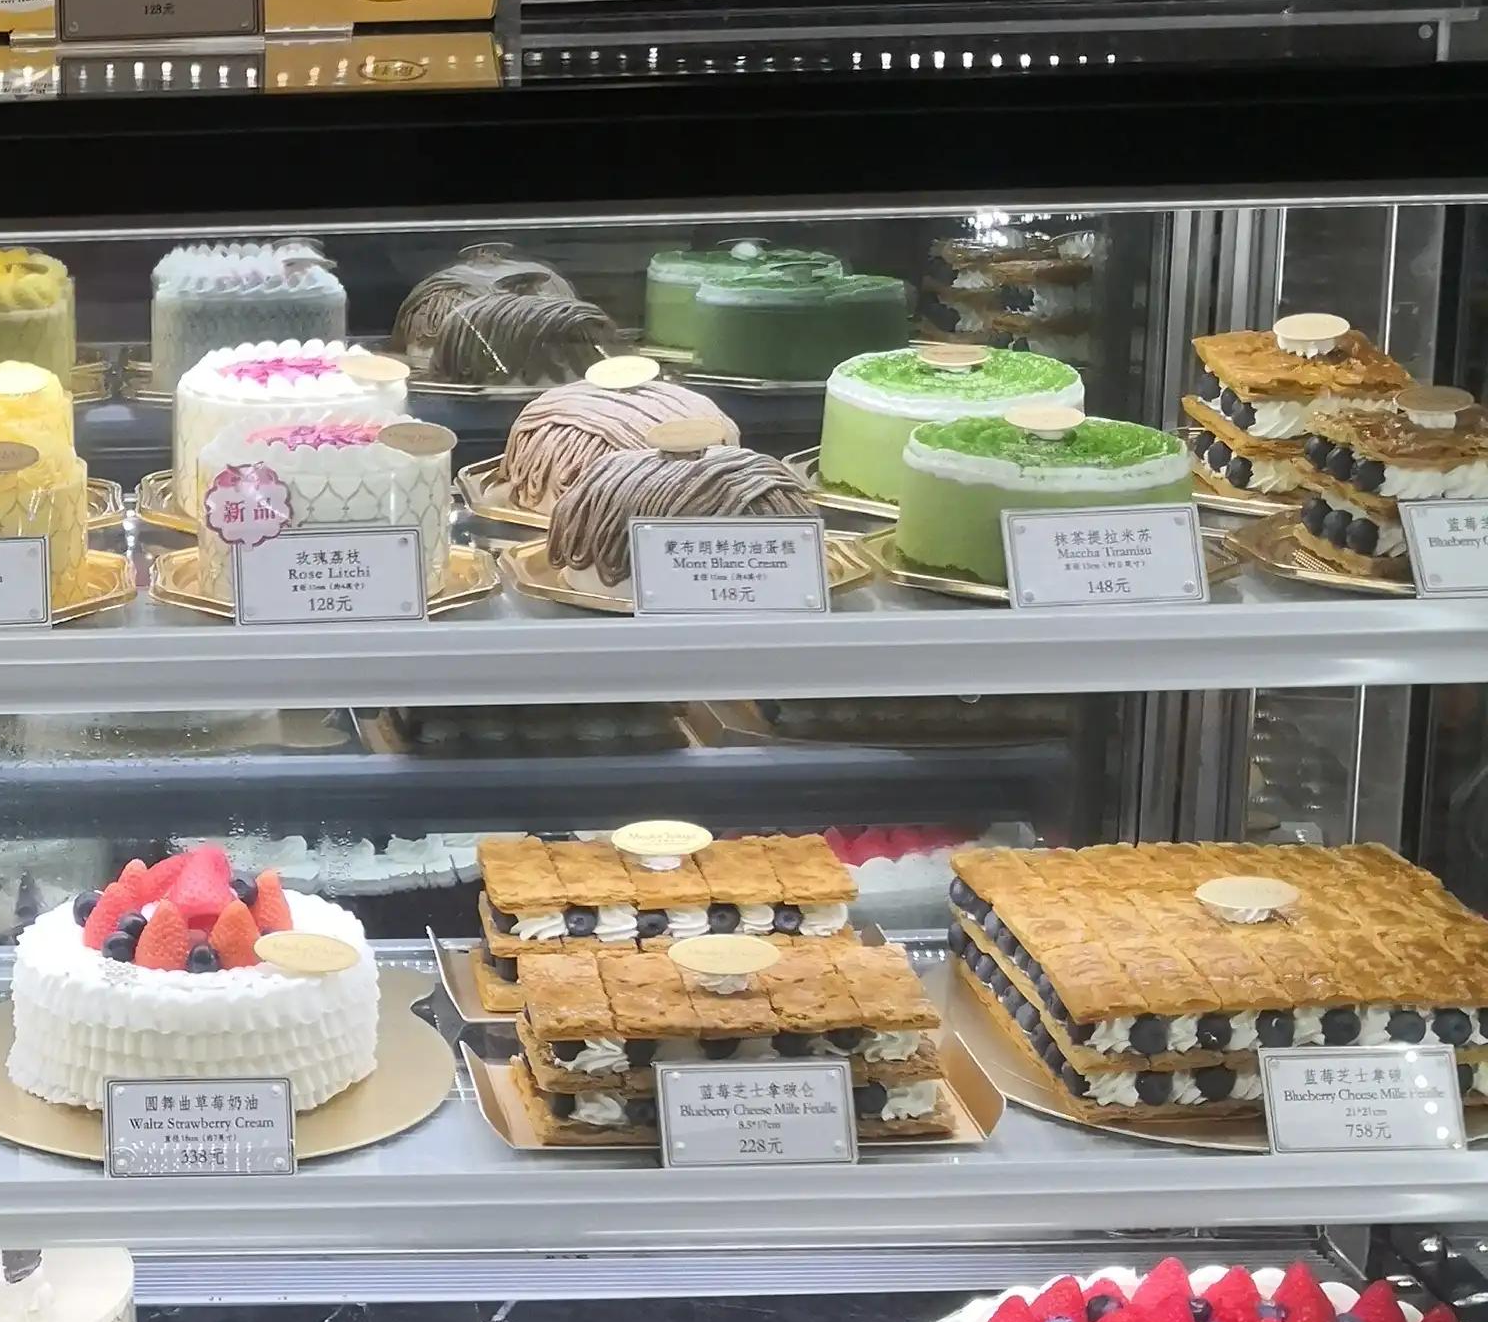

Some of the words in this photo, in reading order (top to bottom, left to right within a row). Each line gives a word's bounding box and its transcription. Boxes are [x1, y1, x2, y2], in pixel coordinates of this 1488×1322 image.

[1054, 528, 1152, 547] 抹茶提拉米苏
[664, 539, 797, 556] 蒙布朗鲜奶油蛋糕
[1058, 548, 1100, 559] Maccha
[1102, 546, 1152, 558] Tiramisu
[296, 549, 361, 565] 玫瑰荔枝
[672, 557, 707, 569] Mont
[711, 557, 745, 569] Blanc
[747, 557, 788, 569] Cream
[288, 568, 323, 580] Rose
[327, 565, 371, 579] Litchi
[1087, 578, 1131, 594] 148元
[710, 586, 756, 603] 148元
[308, 595, 353, 612] 128元
[698, 1081, 814, 1100] 蓝莓芝士拿破仑
[1283, 1089, 1335, 1103] Blueberry
[1337, 1088, 1377, 1100] Cheese
[1379, 1088, 1406, 1099] Mille
[680, 1104, 730, 1118] Blueberry
[733, 1103, 772, 1116] Cheese
[773, 1103, 800, 1115] Mille
[802, 1102, 837, 1114] Feuille
[129, 1118, 164, 1130] Waltz
[167, 1117, 231, 1131] Strawberry
[234, 1116, 274, 1128] Cream
[1345, 1122, 1392, 1139] 758元
[739, 1138, 784, 1154] 228元
[180, 1148, 225, 1165] 338元
